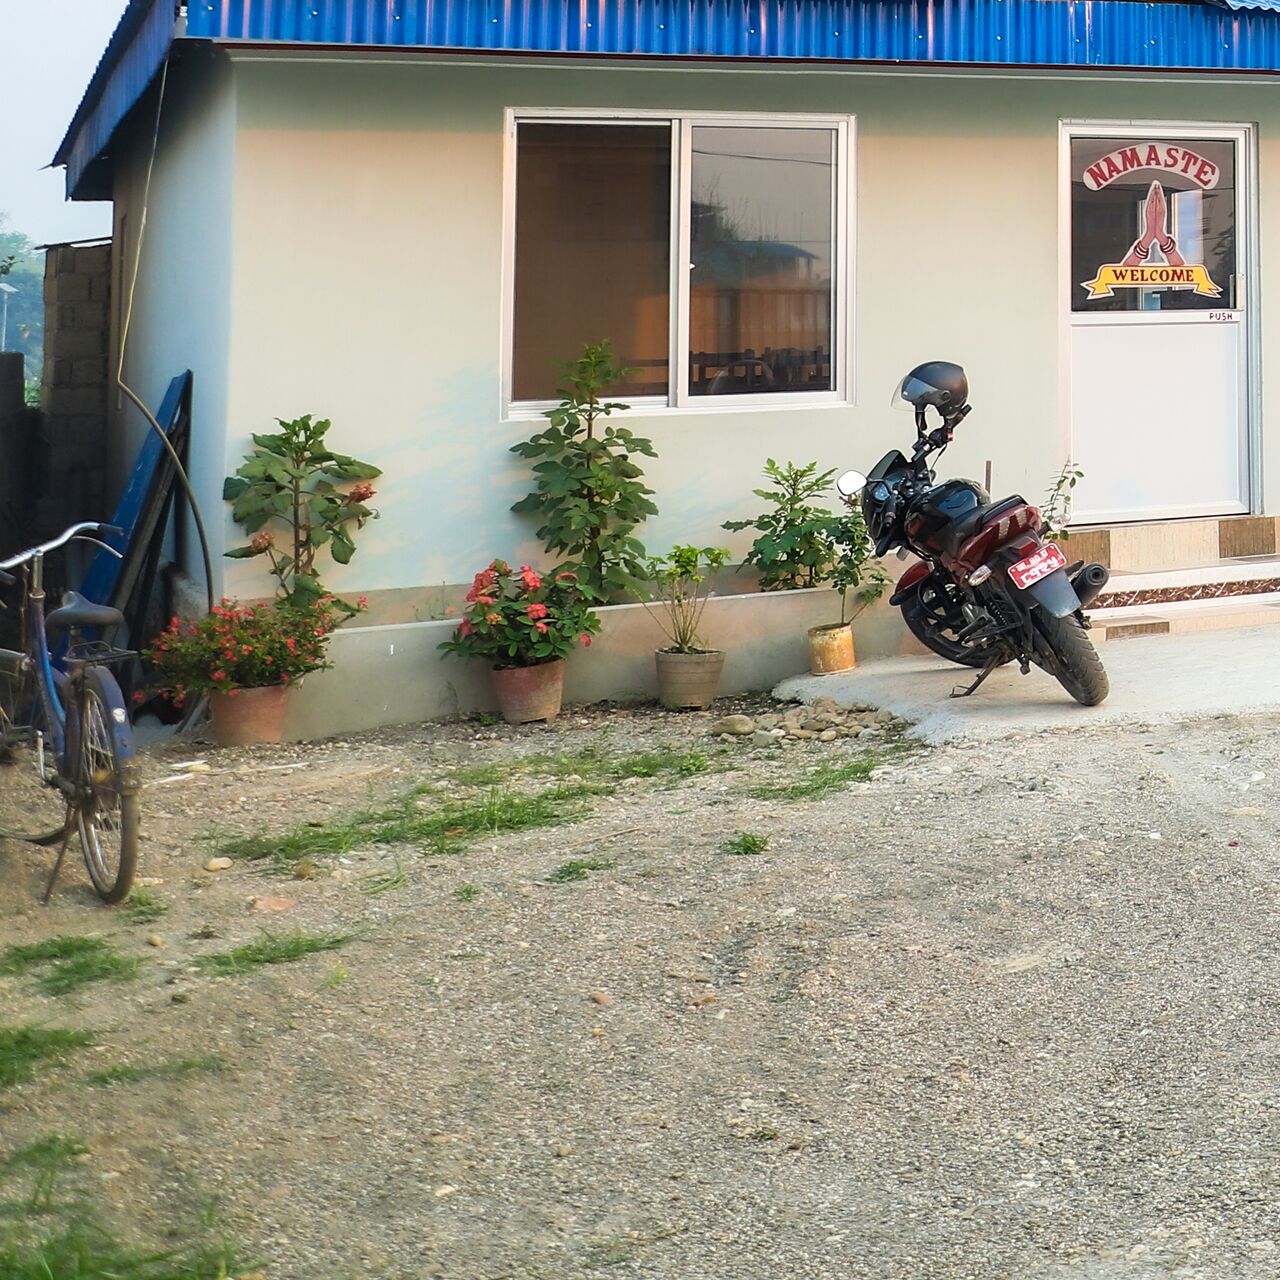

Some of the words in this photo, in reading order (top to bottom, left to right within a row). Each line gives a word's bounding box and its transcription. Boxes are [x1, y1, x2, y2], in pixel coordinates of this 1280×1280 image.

[1086, 144, 1218, 189] NAMASTE
[1112, 269, 1194, 282] WELCOME
[1209, 312, 1233, 321] PUSH
